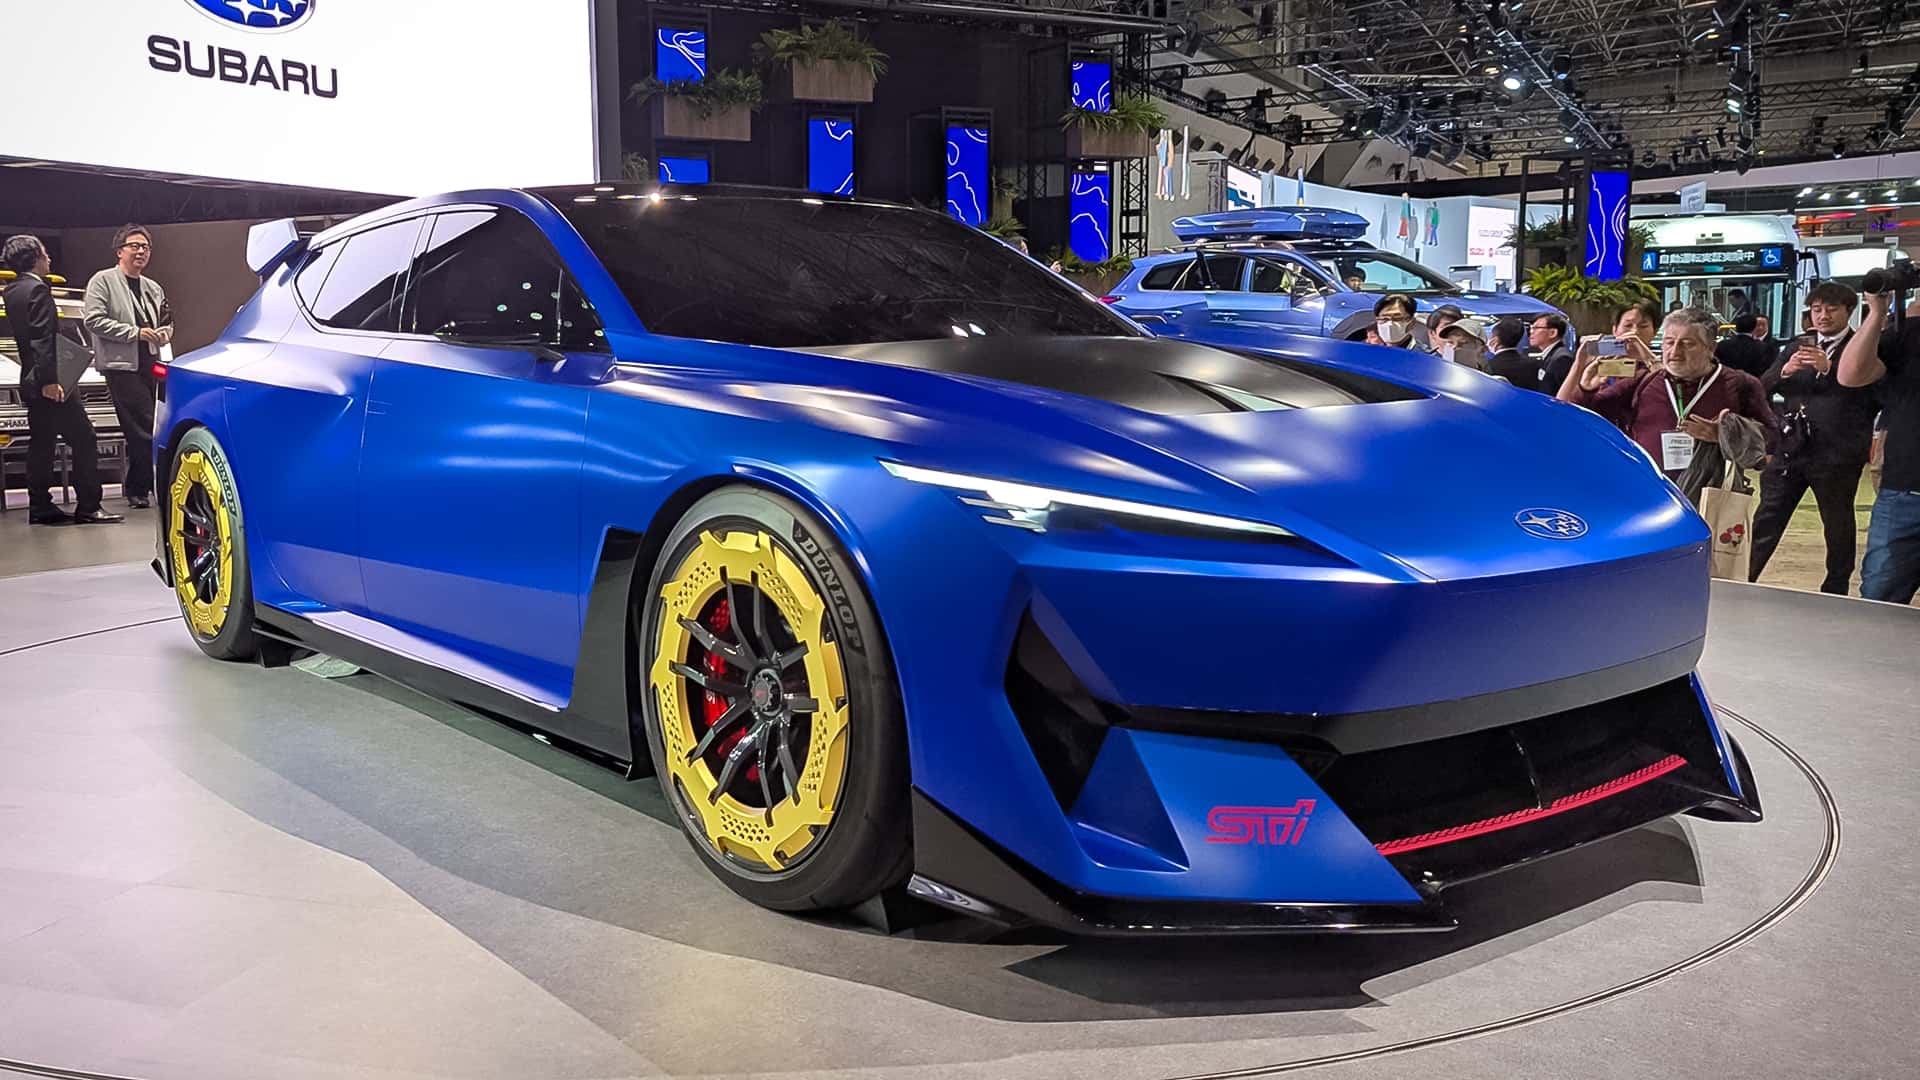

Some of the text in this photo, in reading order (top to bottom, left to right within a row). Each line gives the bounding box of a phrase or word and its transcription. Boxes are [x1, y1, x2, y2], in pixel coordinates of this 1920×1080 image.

[147, 34, 338, 99] SUBARU
[212, 453, 236, 513] DUNLOP
[800, 537, 863, 650] DUNLOP
